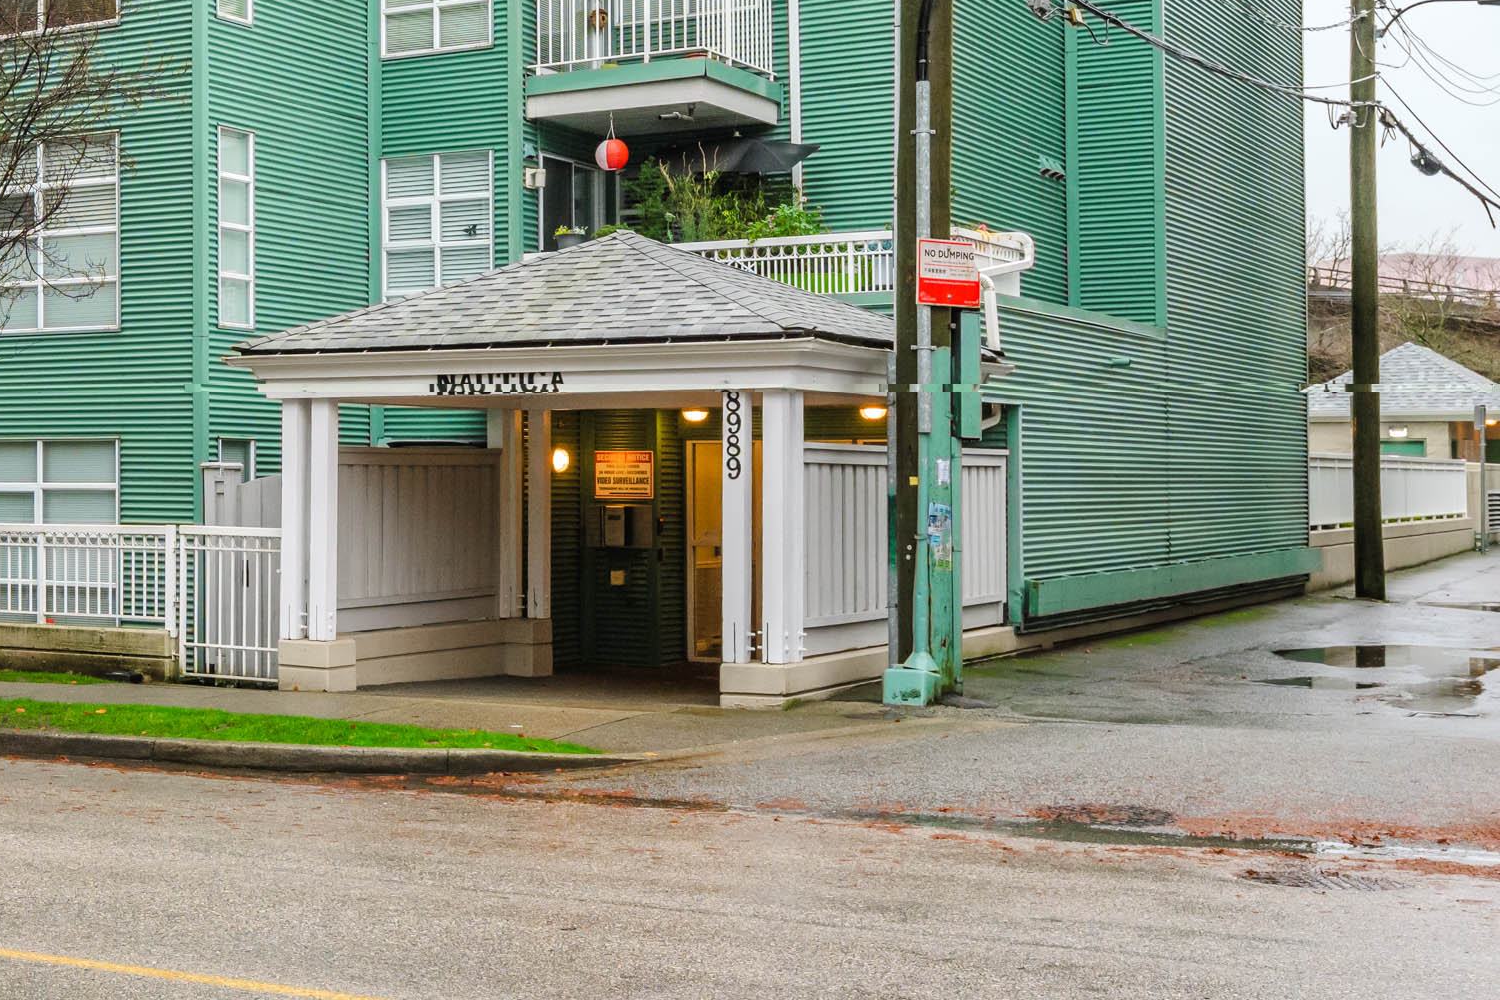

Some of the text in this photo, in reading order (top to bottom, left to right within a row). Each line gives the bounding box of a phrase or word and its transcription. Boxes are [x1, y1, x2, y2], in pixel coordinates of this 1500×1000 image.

[924, 249, 975, 261] NO DUMPING
[430, 372, 564, 395] NAUTICA
[725, 389, 742, 480] 8989
[597, 477, 650, 485] VIDEO SURVEILLANCE
